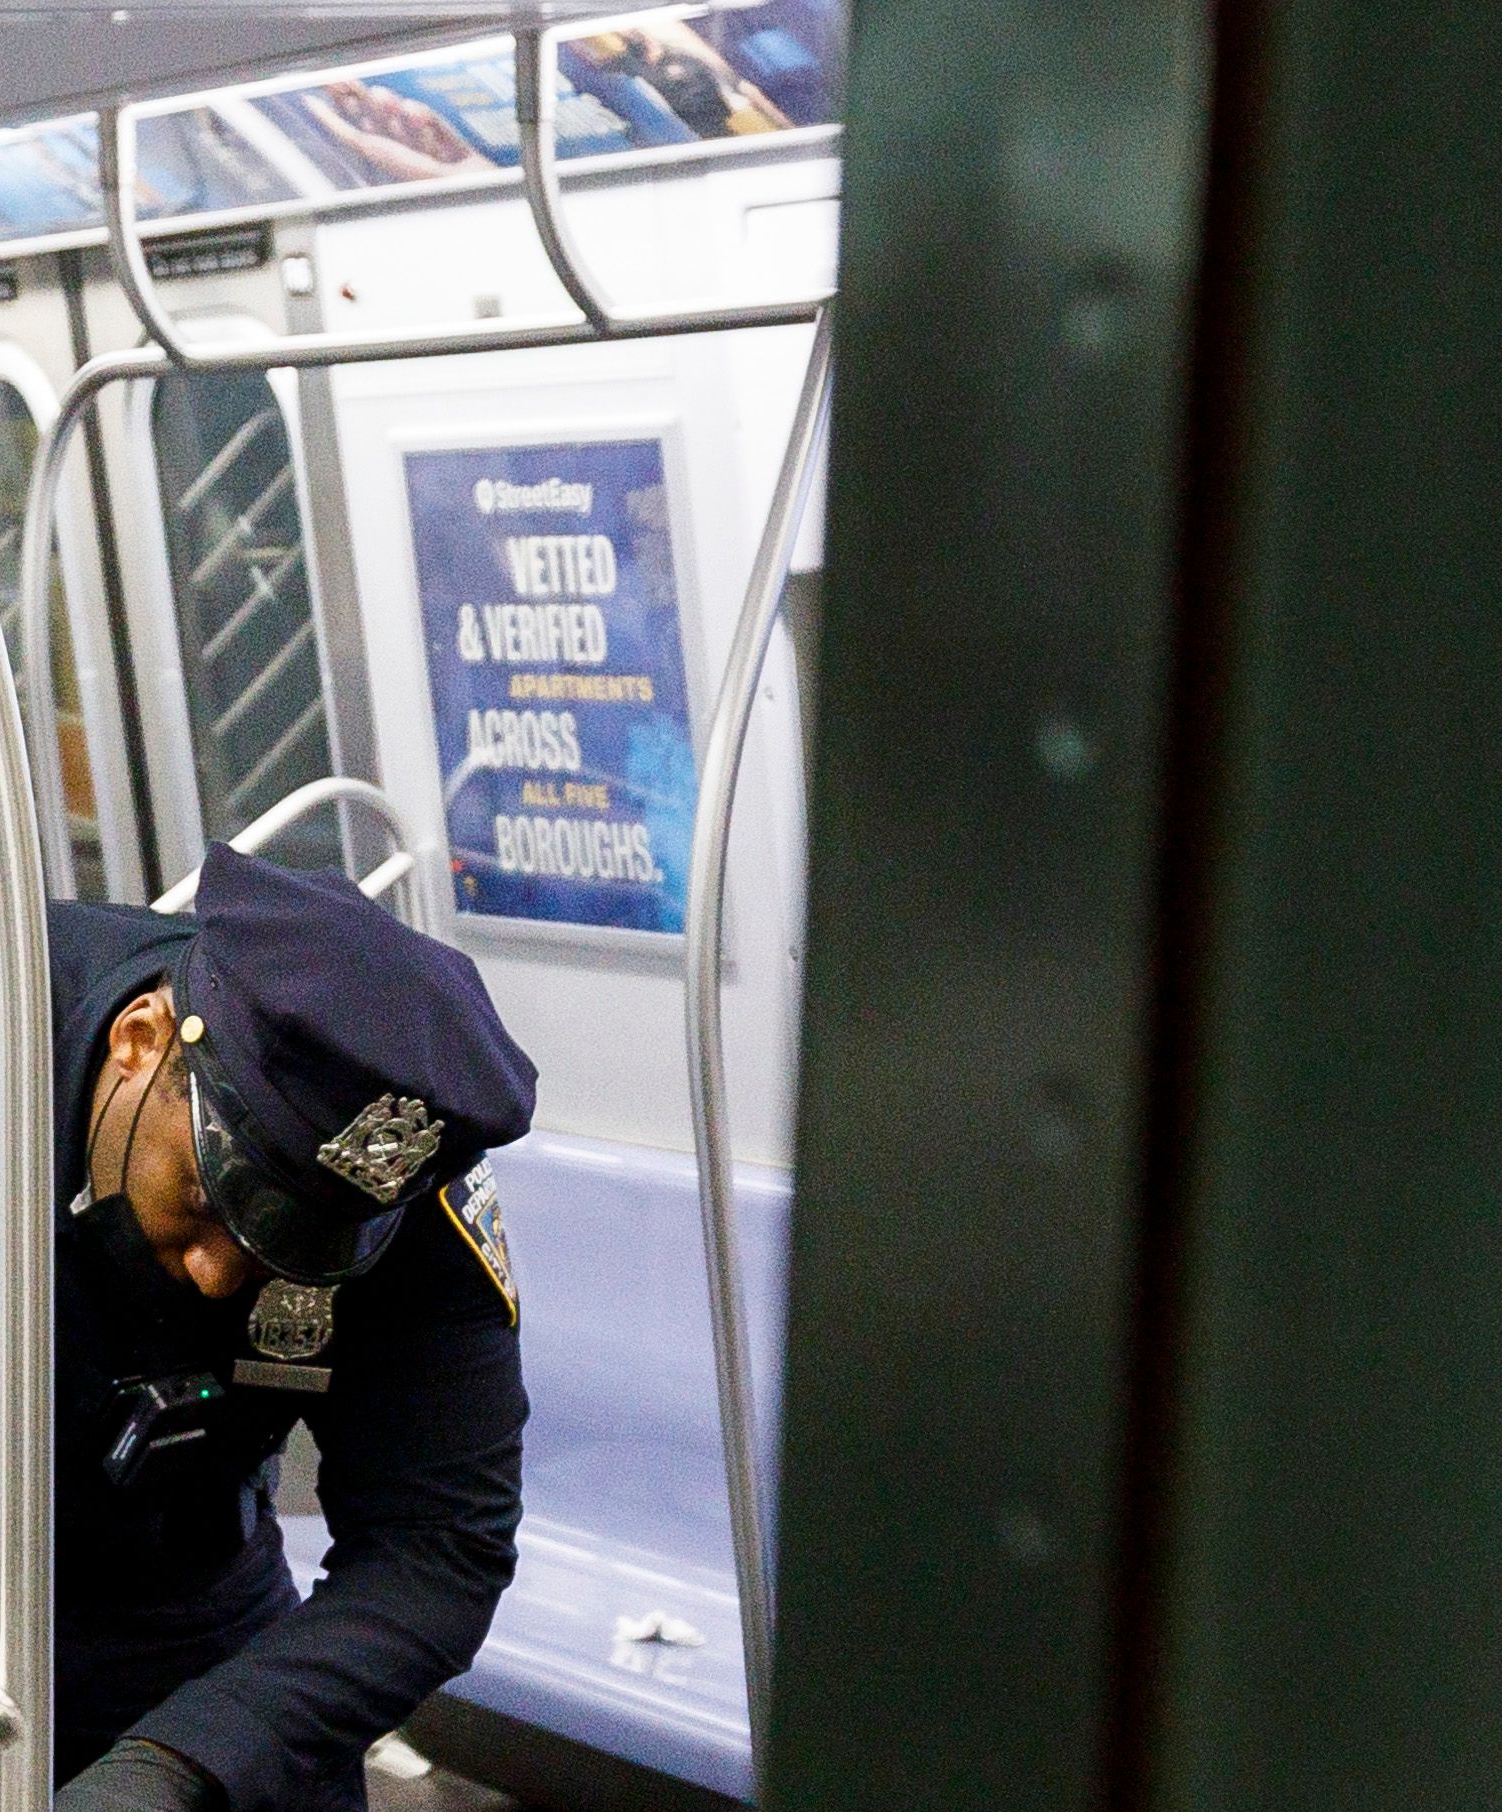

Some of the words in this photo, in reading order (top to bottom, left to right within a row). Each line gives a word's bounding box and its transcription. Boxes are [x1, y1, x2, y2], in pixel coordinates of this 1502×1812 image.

[506, 534, 616, 596] VETTED
[458, 603, 484, 662] &
[484, 603, 607, 662] VERIFIED
[508, 674, 654, 702] APARTMENTS
[467, 708, 582, 770] ACROSS
[496, 814, 663, 882] BOROUGHS.
